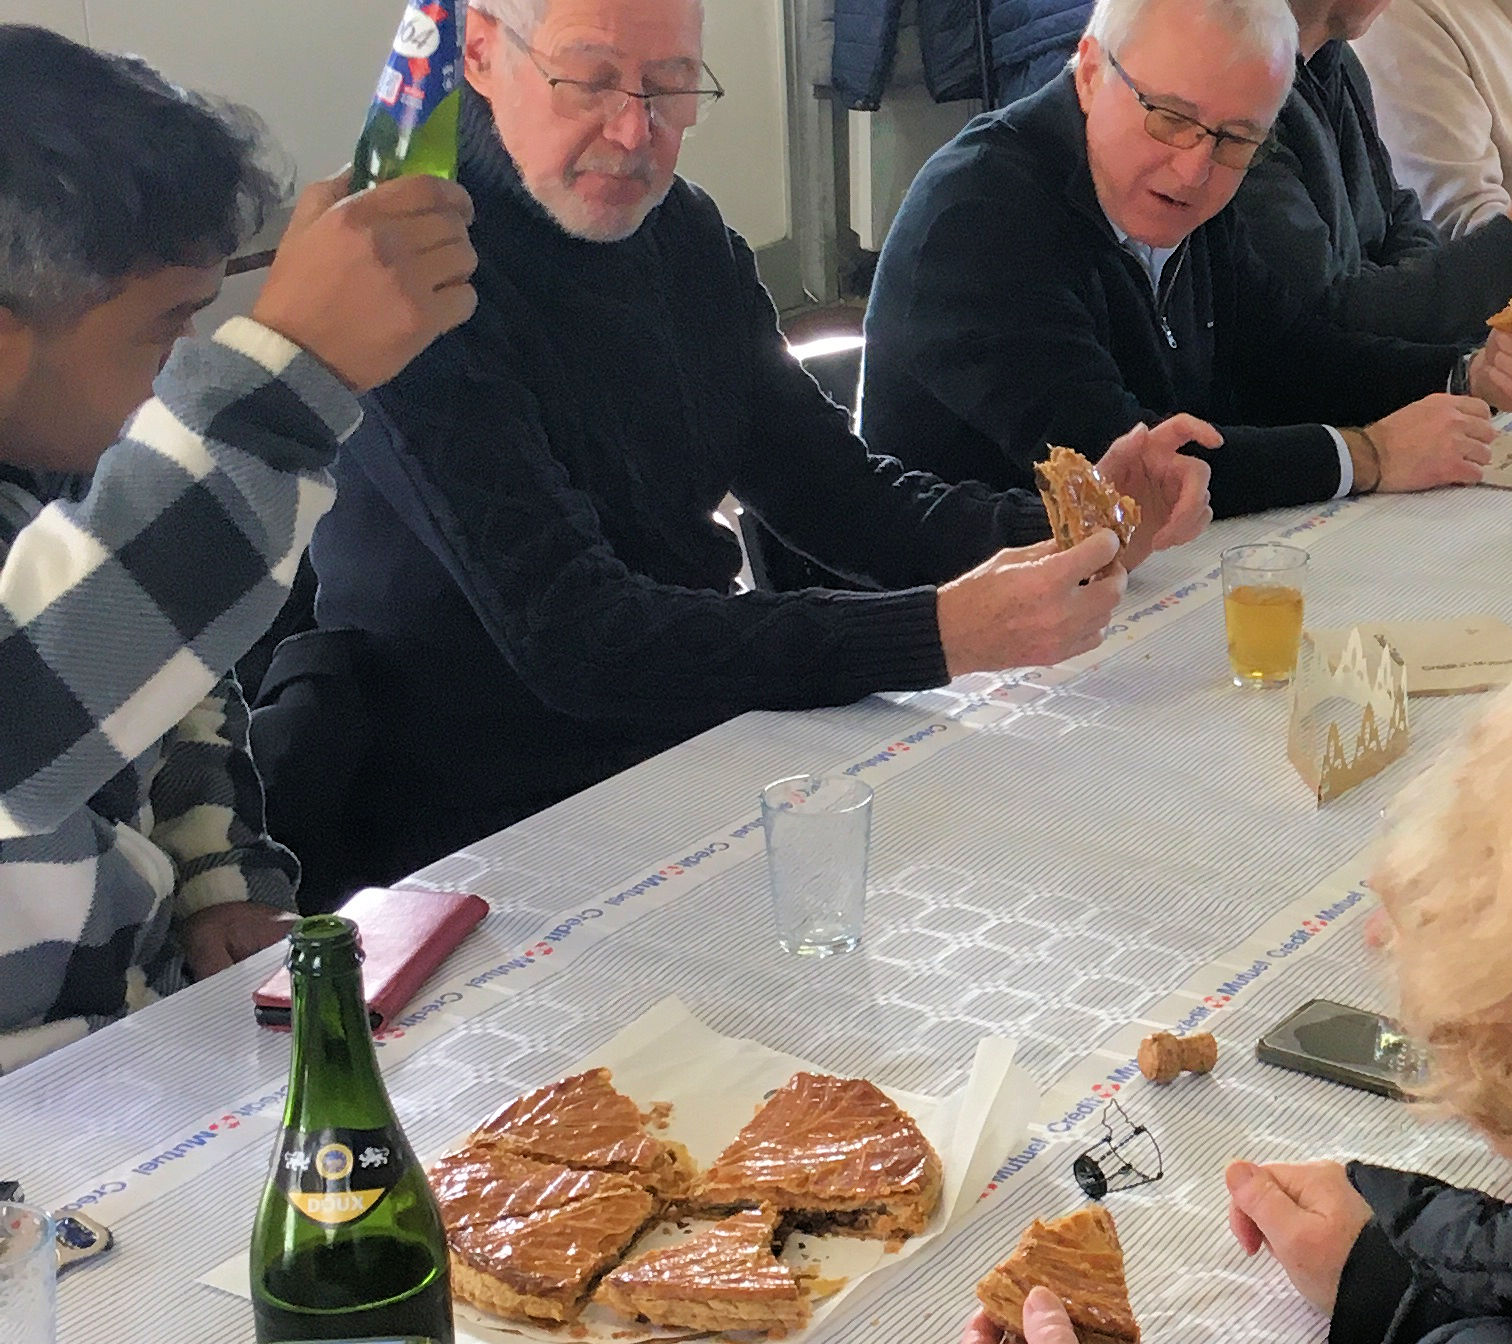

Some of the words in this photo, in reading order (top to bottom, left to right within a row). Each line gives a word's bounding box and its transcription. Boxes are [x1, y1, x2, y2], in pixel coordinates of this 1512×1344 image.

[605, 873, 667, 906] Mutuel
[544, 908, 604, 943] Crédit
[464, 955, 536, 988] Mutuel
[1216, 960, 1272, 996] Mutuel
[1266, 929, 1315, 958] Crédit
[131, 1130, 218, 1175] Mutuel
[993, 1136, 1051, 1184] Mutuel
[1047, 1096, 1105, 1133] Crédit
[307, 1196, 364, 1213] DOUX
